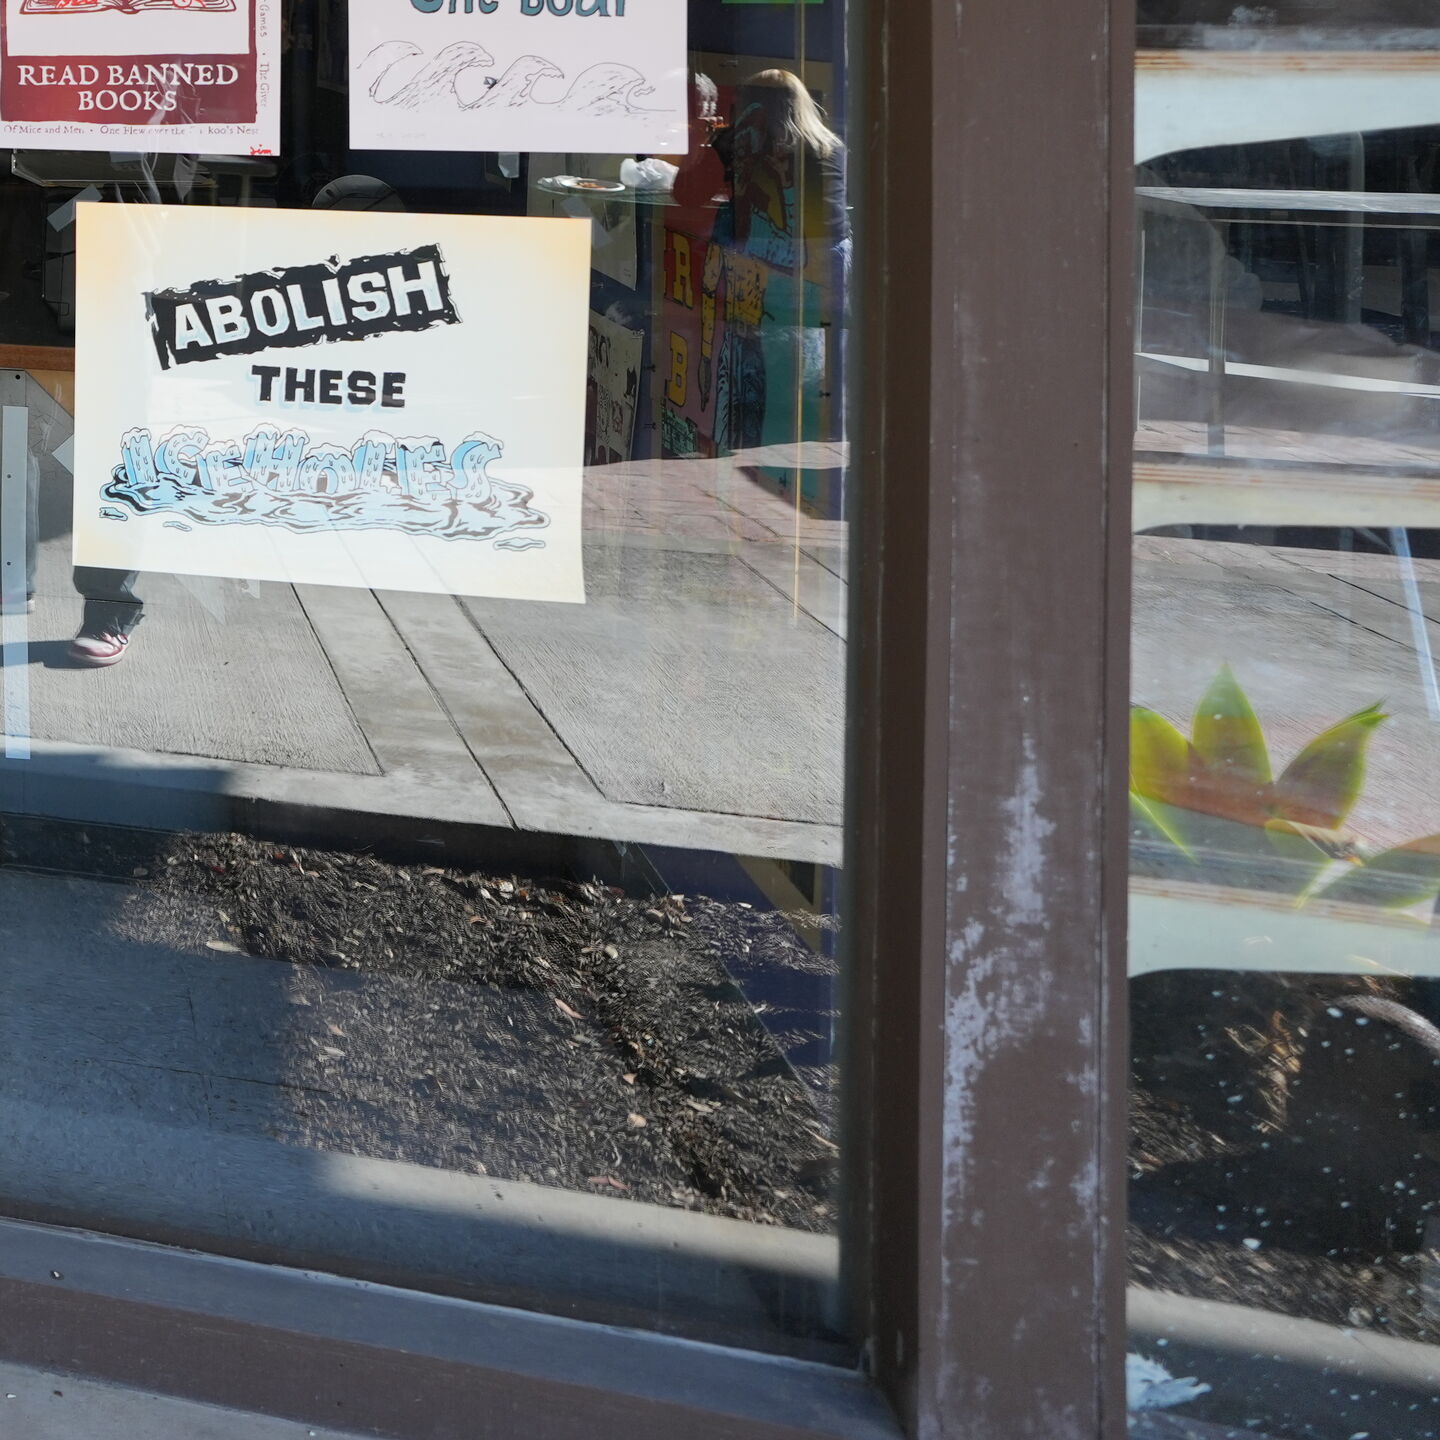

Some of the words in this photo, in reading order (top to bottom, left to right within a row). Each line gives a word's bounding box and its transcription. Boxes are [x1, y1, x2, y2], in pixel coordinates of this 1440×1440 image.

[17, 63, 99, 88] READ
[105, 62, 239, 88] BANNED
[77, 88, 179, 113] BOOKS
[18, 125, 42, 135] Mice
[45, 125, 61, 135] and
[99, 125, 120, 135] One
[123, 125, 146, 135] Flew
[174, 261, 445, 351] ABOLISH
[250, 364, 407, 409] THESE
